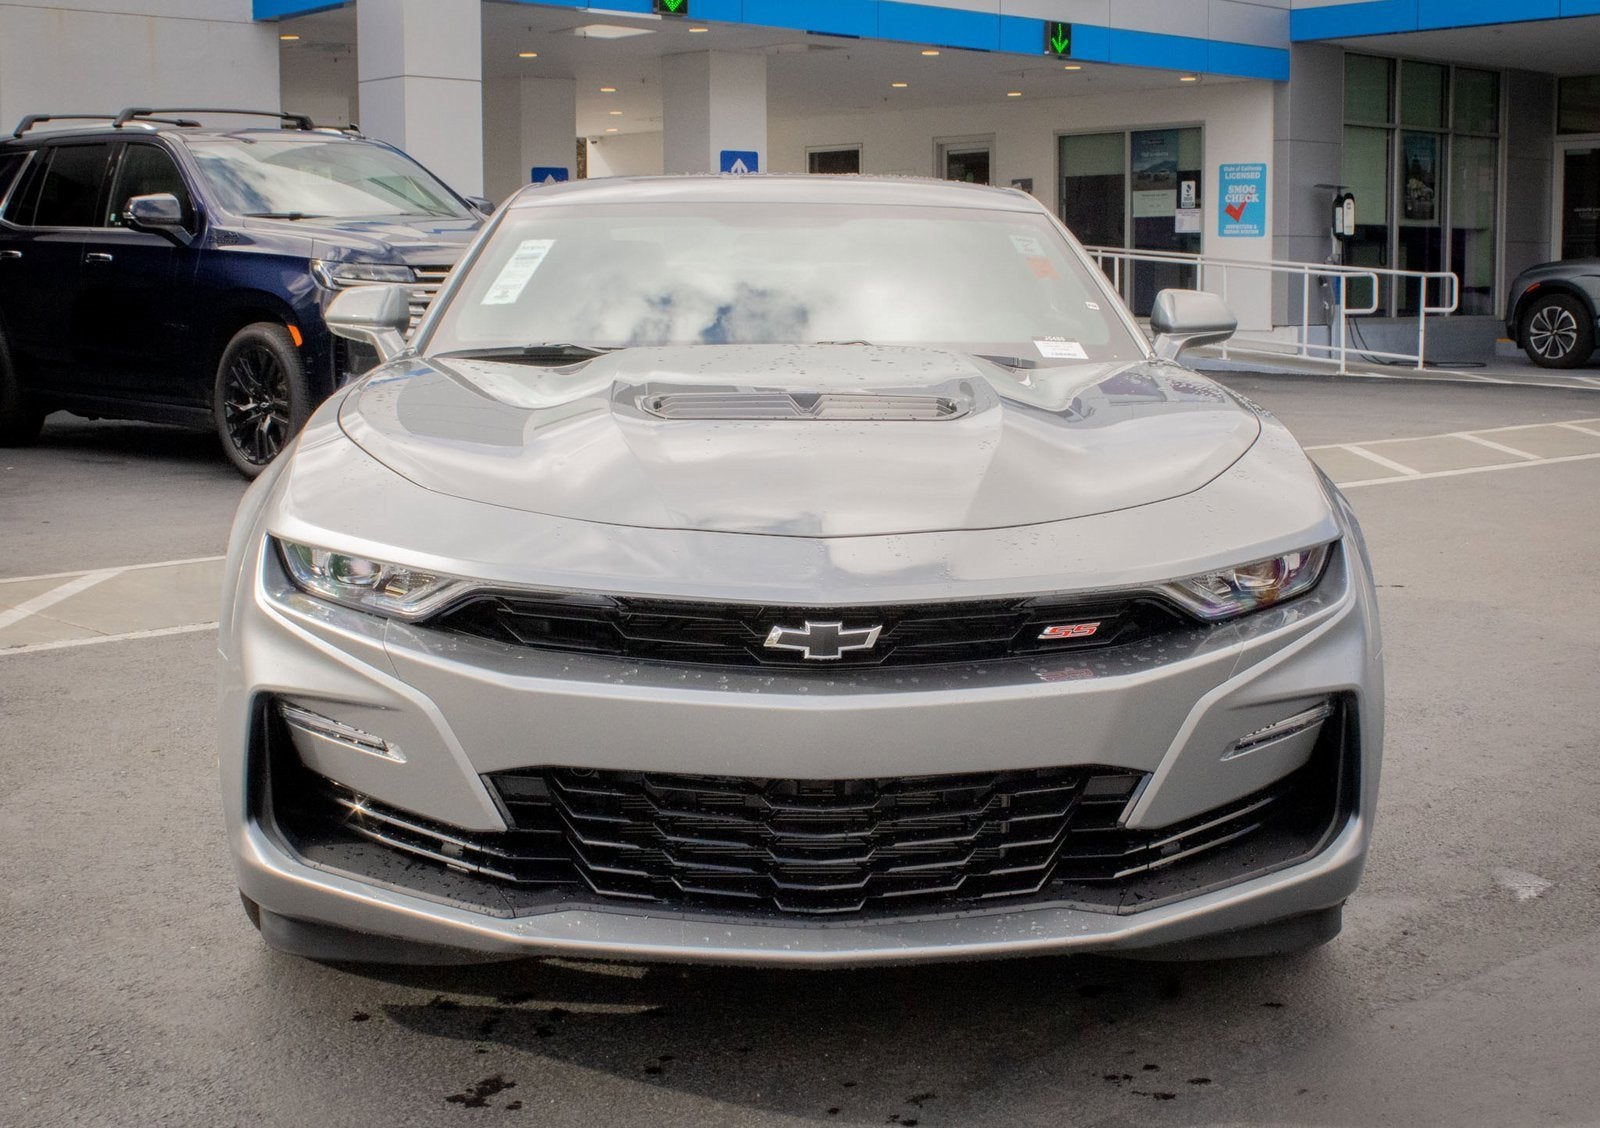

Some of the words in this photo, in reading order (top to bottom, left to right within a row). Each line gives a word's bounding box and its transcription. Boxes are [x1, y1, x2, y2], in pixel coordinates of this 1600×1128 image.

[1225, 172, 1261, 180] LICENSED
[1228, 185, 1256, 194] SMOG
[1225, 193, 1259, 203] CHECK
[1037, 621, 1101, 640] SS
